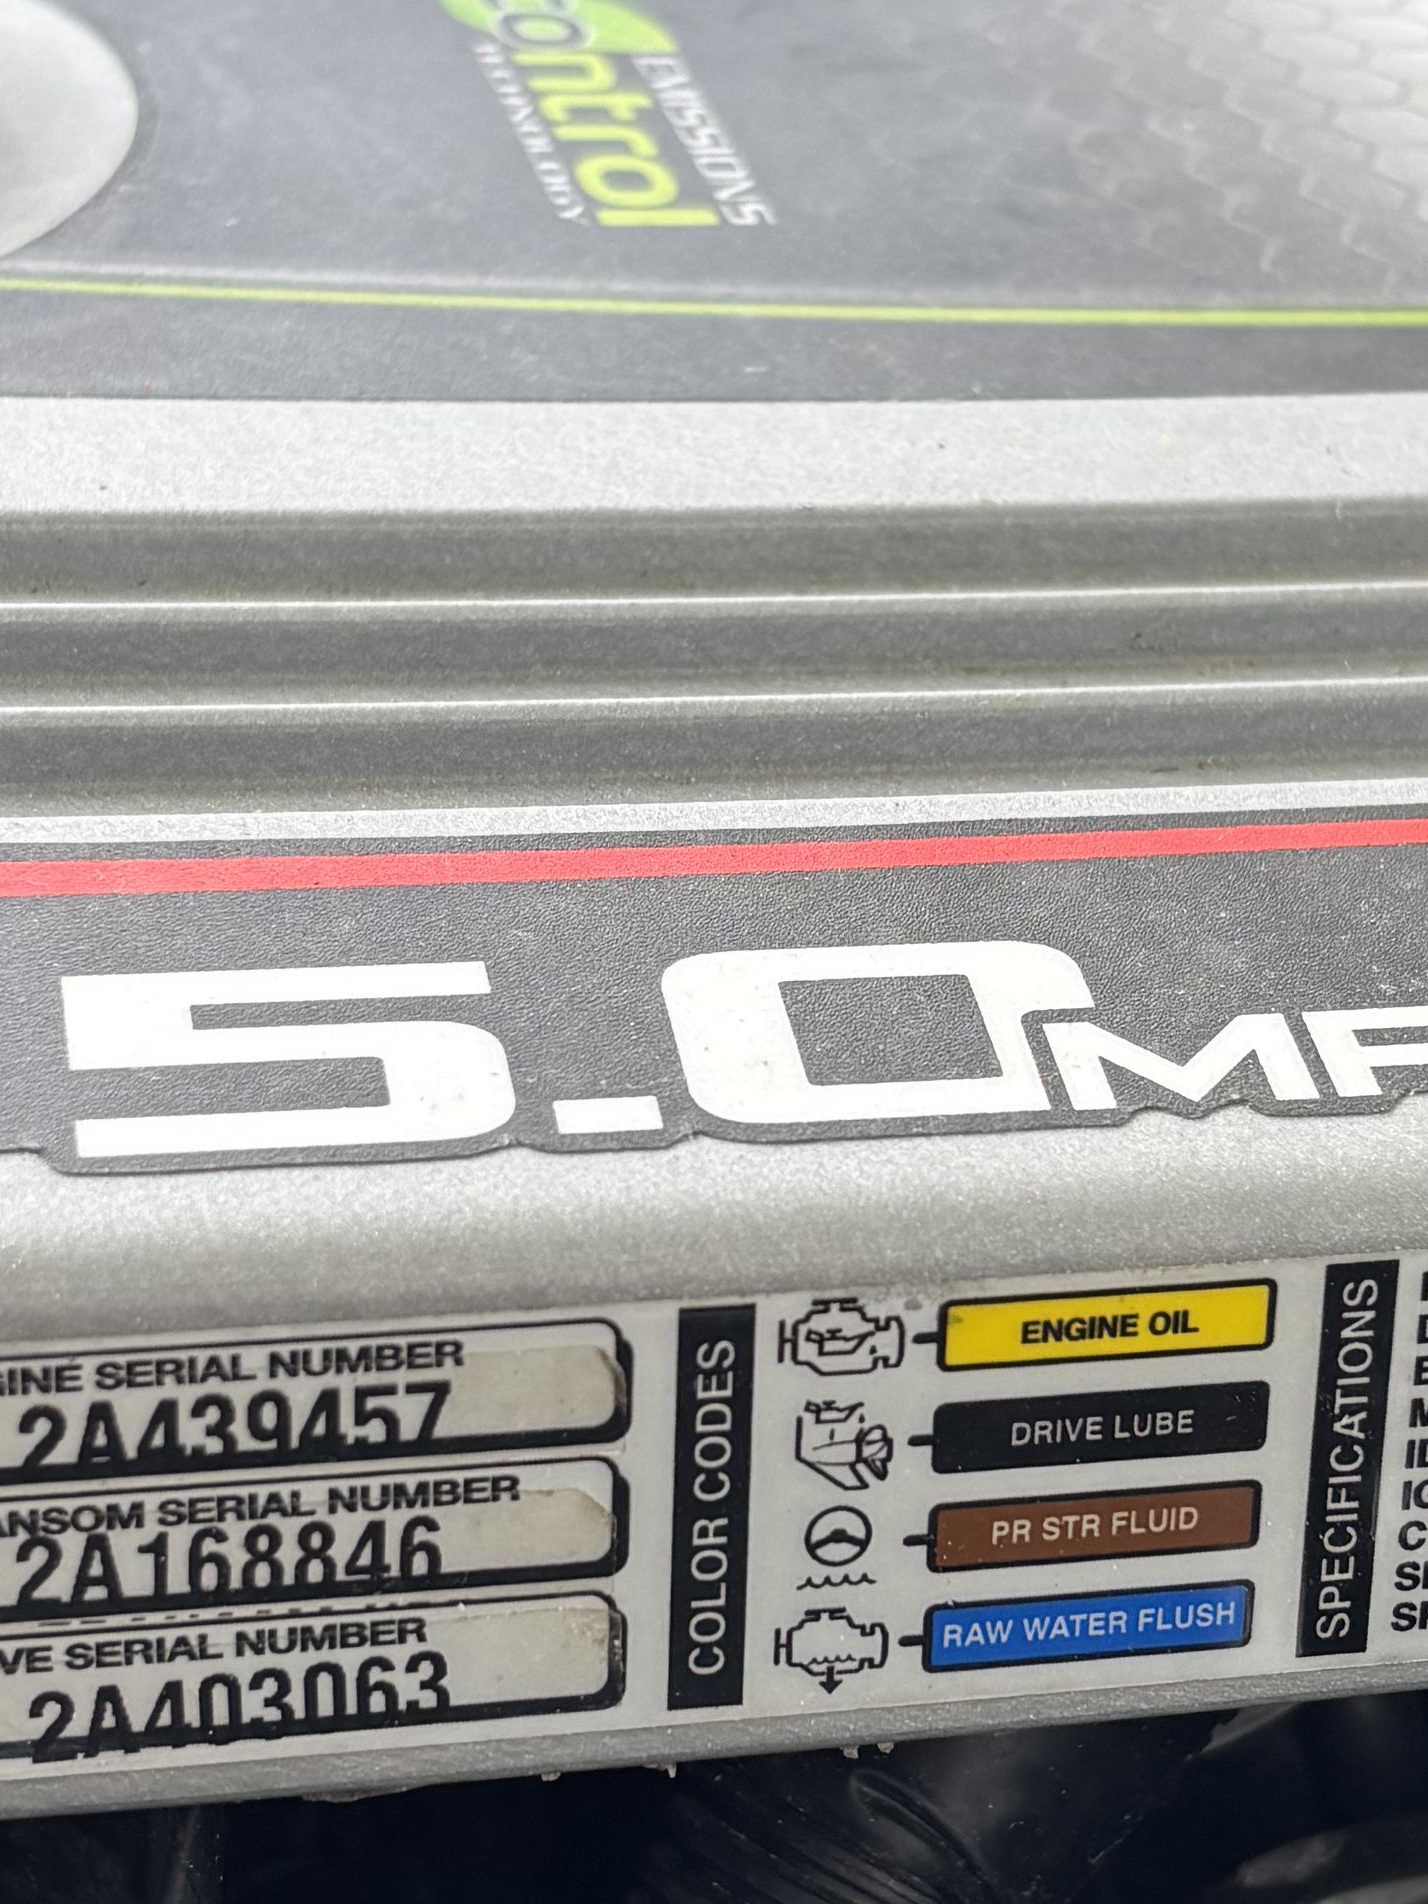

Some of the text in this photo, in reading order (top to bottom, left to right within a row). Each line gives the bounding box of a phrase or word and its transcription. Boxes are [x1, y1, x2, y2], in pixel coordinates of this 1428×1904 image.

[632, 53, 778, 227] EMISSIONS
[61, 939, 1099, 1158] 5.0
[1020, 1308, 1201, 1345] ENGINE OIL
[95, 1351, 258, 1392] SERIAL
[267, 1339, 466, 1380] NUMBER
[14, 1378, 455, 1470] 2A439457
[1011, 1410, 1194, 1448] DRIVE LUBE
[1317, 1277, 1379, 1641] SPECIFICATIONS
[157, 1487, 319, 1528] SERIAL
[328, 1474, 523, 1516] NUMBER
[687, 1339, 737, 1676] COLOR CODES
[990, 1505, 1200, 1546] PR STR FLUID
[12, 1514, 446, 1608] 2A168846
[65, 1630, 225, 1672] SERIAL
[234, 1617, 428, 1658] NUMBER
[942, 1601, 1236, 1650] RAW WATER FLUSH
[28, 1650, 452, 1764] 2A403063
